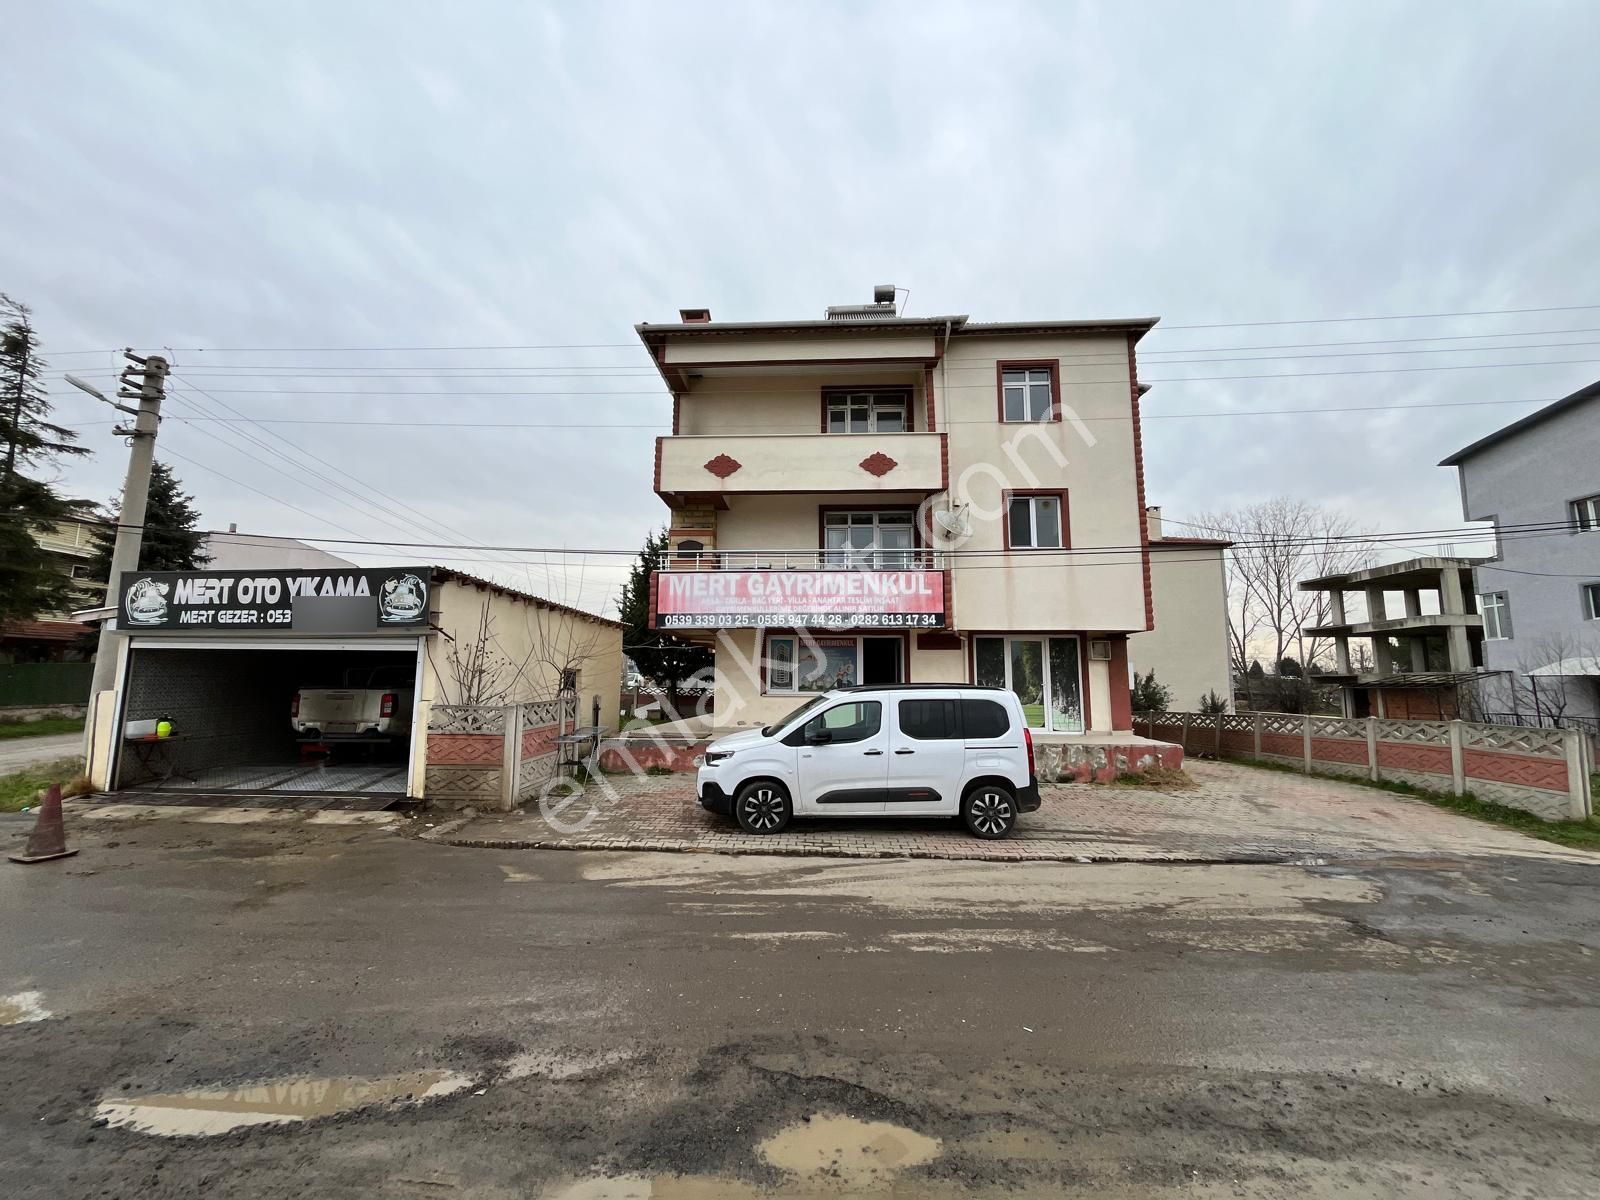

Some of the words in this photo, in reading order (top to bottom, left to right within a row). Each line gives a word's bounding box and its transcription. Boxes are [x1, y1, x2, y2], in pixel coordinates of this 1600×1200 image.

[173, 578, 235, 604] MERT
[238, 577, 281, 604] OTO
[669, 575, 740, 596] MERT
[180, 611, 215, 623] MERT
[217, 610, 258, 623] GEZER
[665, 615, 692, 625] 0539
[694, 615, 716, 625] 339
[718, 615, 733, 625] 03
[734, 615, 749, 625] 25
[757, 615, 785, 625] 0535
[788, 615, 807, 625] 947
[811, 614, 825, 625] 44
[828, 614, 842, 625] 28
[851, 614, 879, 625] 0282
[882, 614, 903, 625] 613
[905, 614, 919, 625] 17
[921, 614, 936, 625] 34
